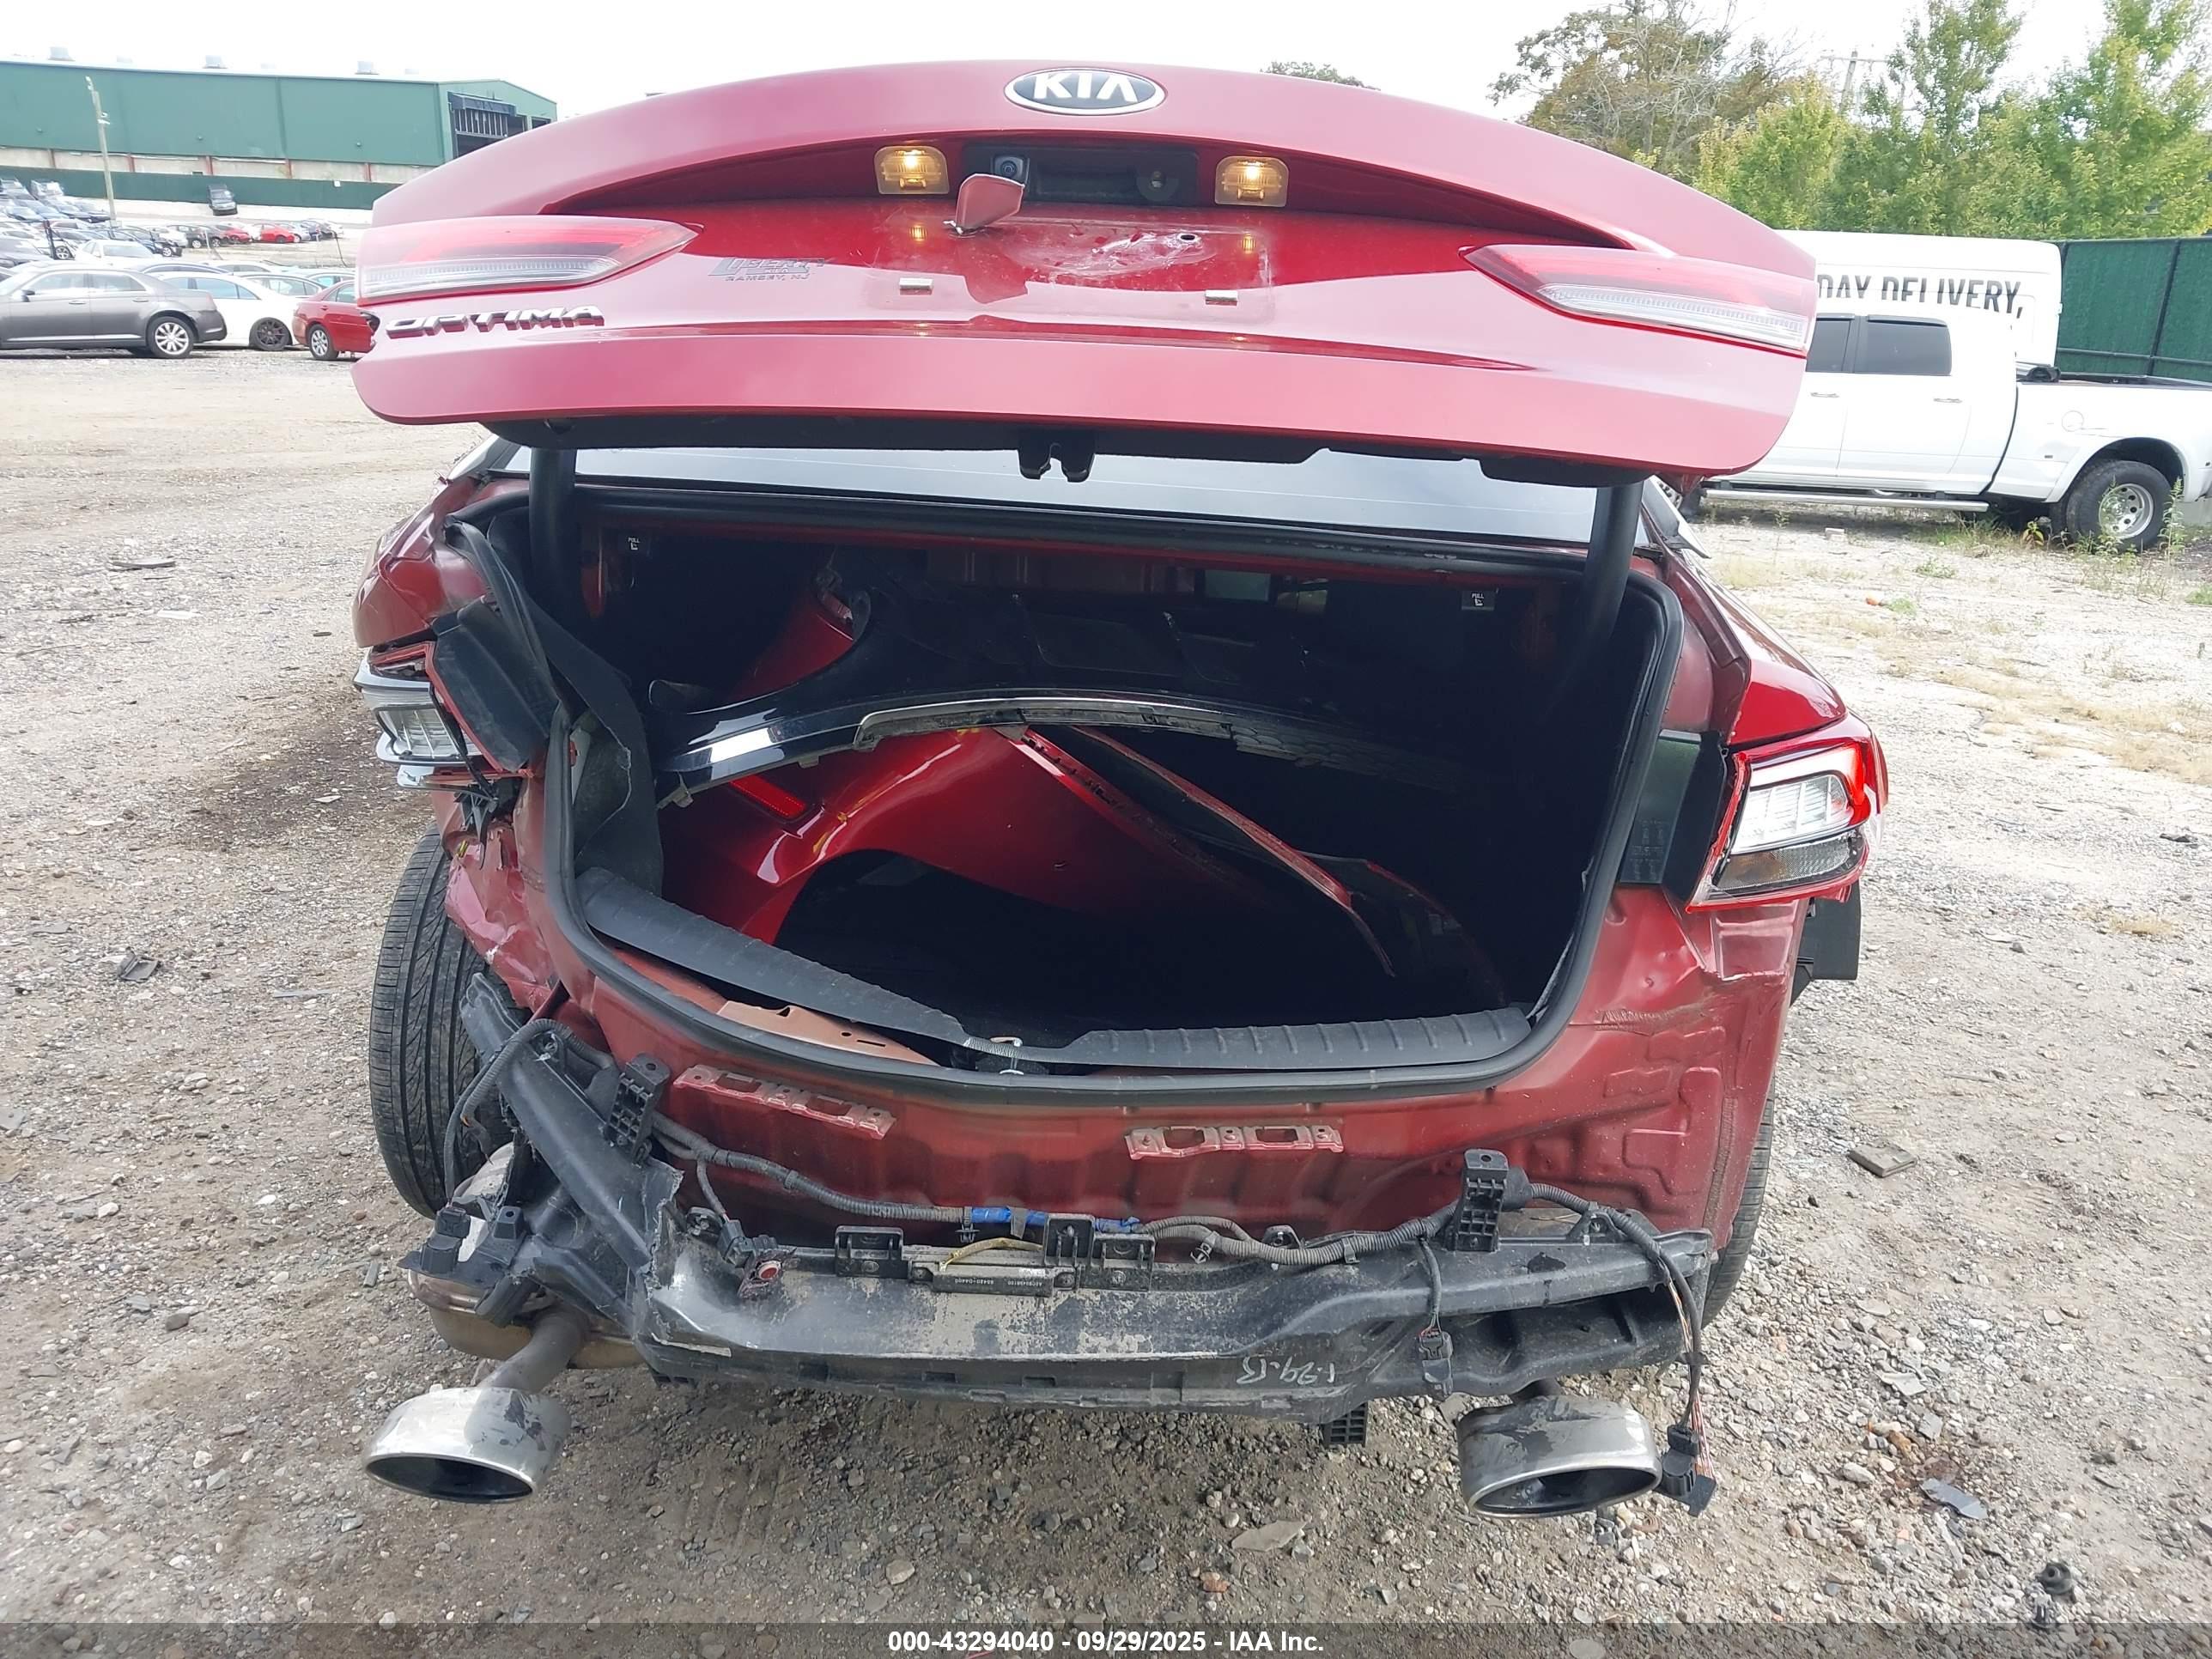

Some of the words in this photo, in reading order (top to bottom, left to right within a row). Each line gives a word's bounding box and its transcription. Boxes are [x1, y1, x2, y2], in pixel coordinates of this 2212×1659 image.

[1034, 72, 1138, 102] KIA
[1817, 274, 1871, 299] DAY
[386, 306, 605, 339] OPTIMA
